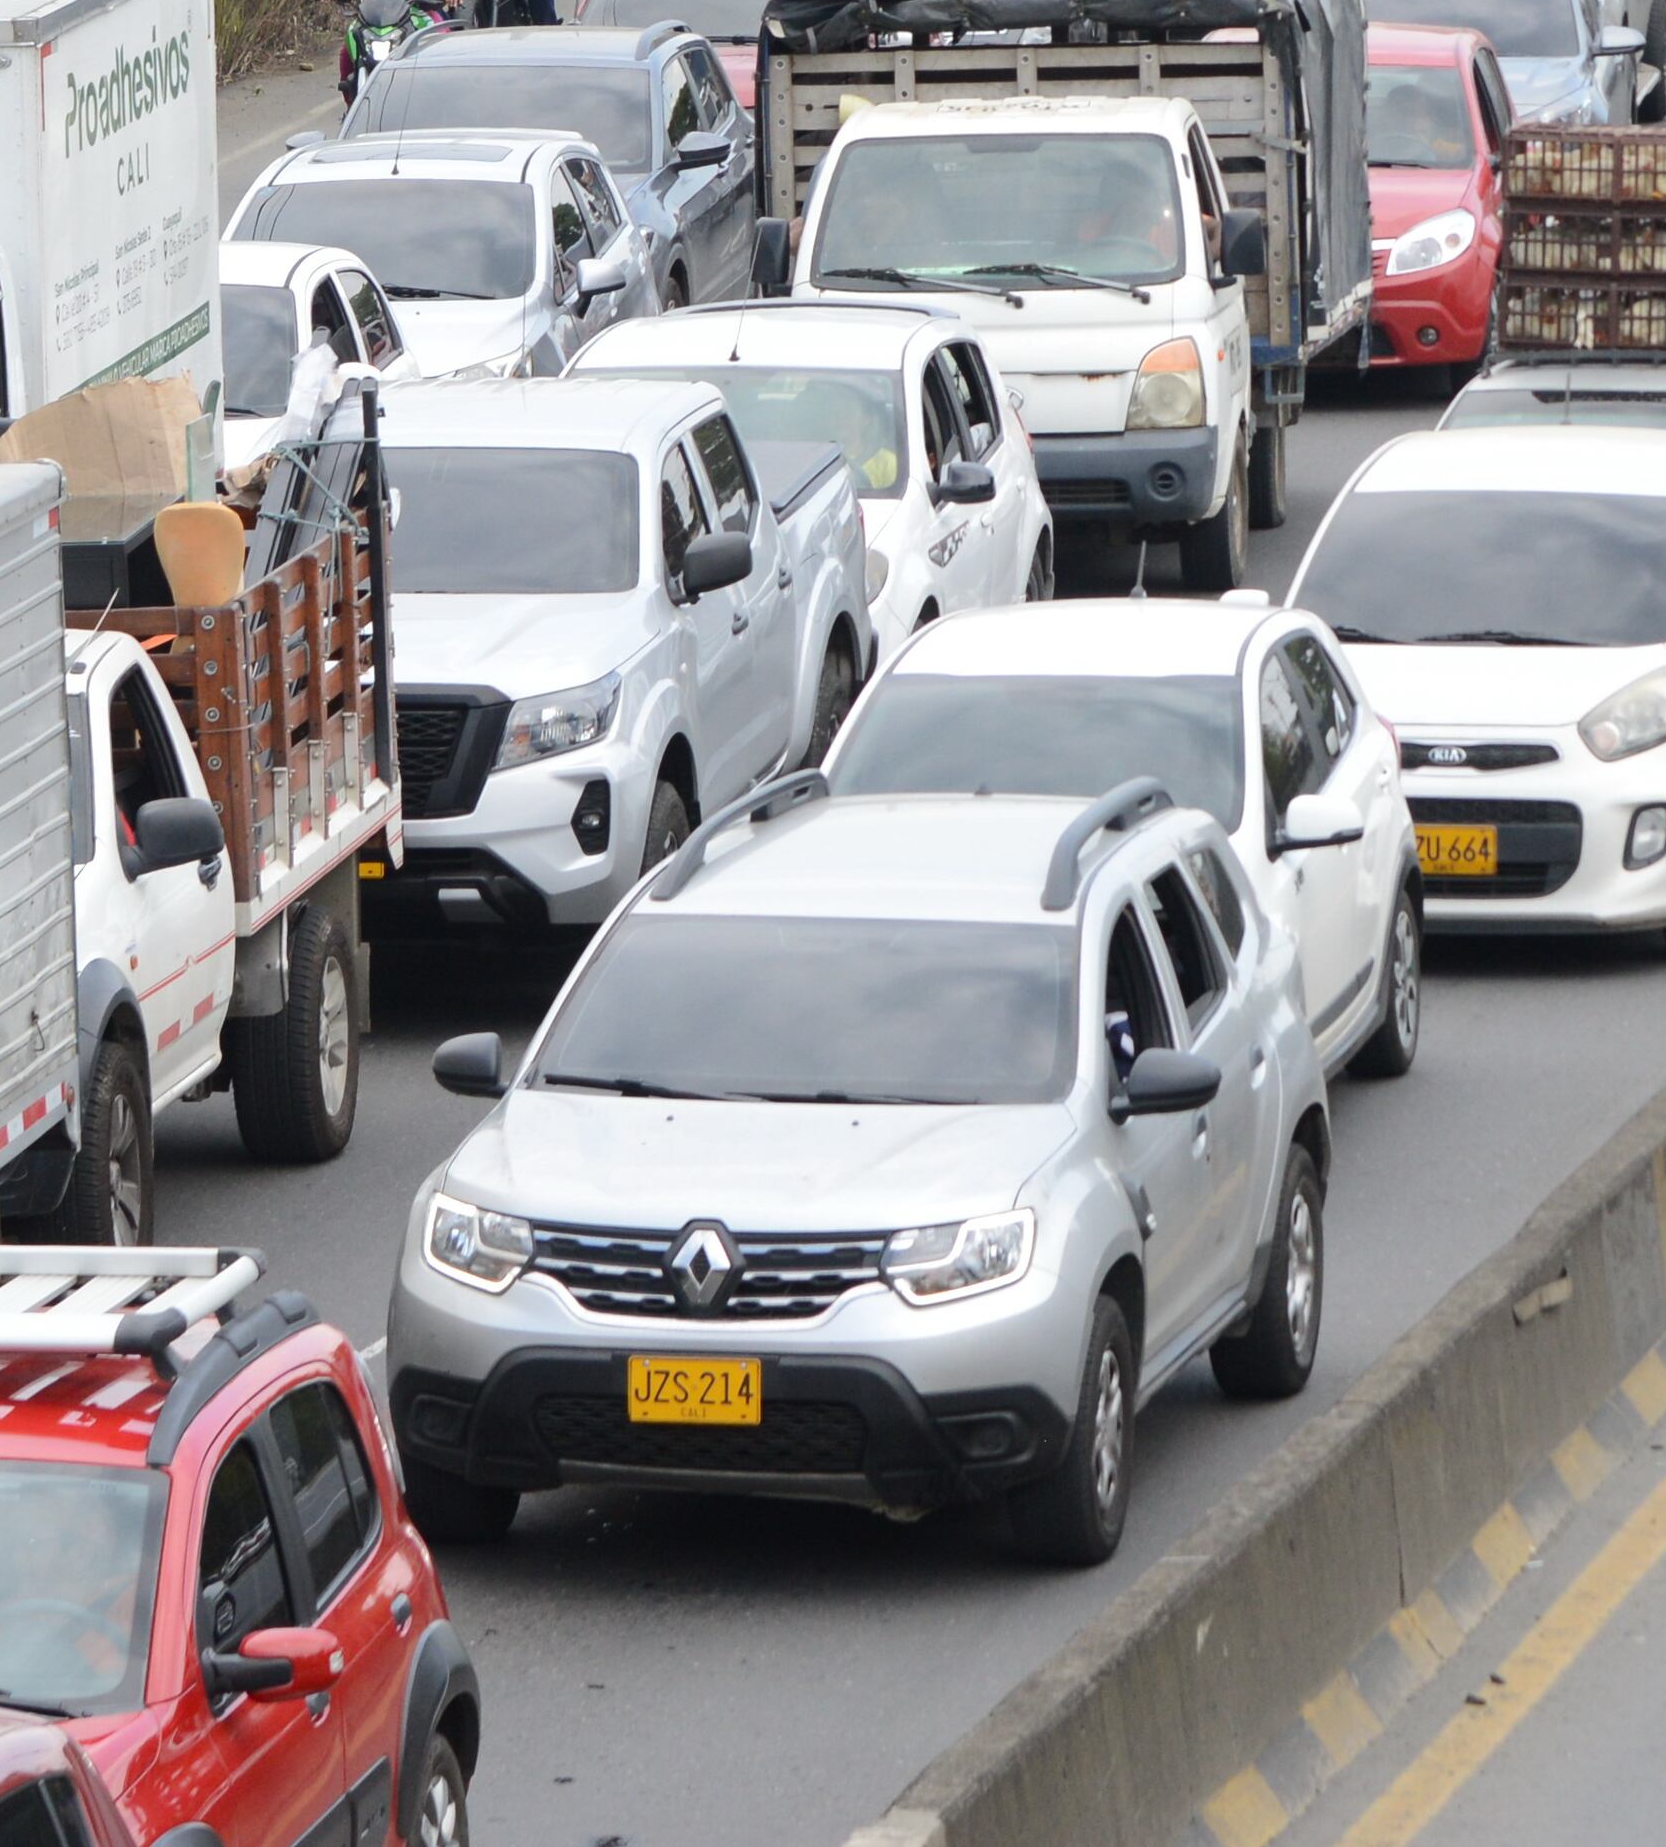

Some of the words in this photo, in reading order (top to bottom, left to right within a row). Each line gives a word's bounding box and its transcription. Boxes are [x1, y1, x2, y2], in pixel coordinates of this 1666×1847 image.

[65, 25, 190, 159] Proadhesivos
[117, 142, 150, 196] CALI
[149, 328, 171, 364] MARCA
[170, 306, 209, 351] PROADHESIVOS
[1430, 747, 1464, 764] KIA
[1447, 836, 1492, 862] 664
[634, 1369, 689, 1403] JZS
[699, 1371, 754, 1406] 214
[680, 1407, 707, 1419] CALI
